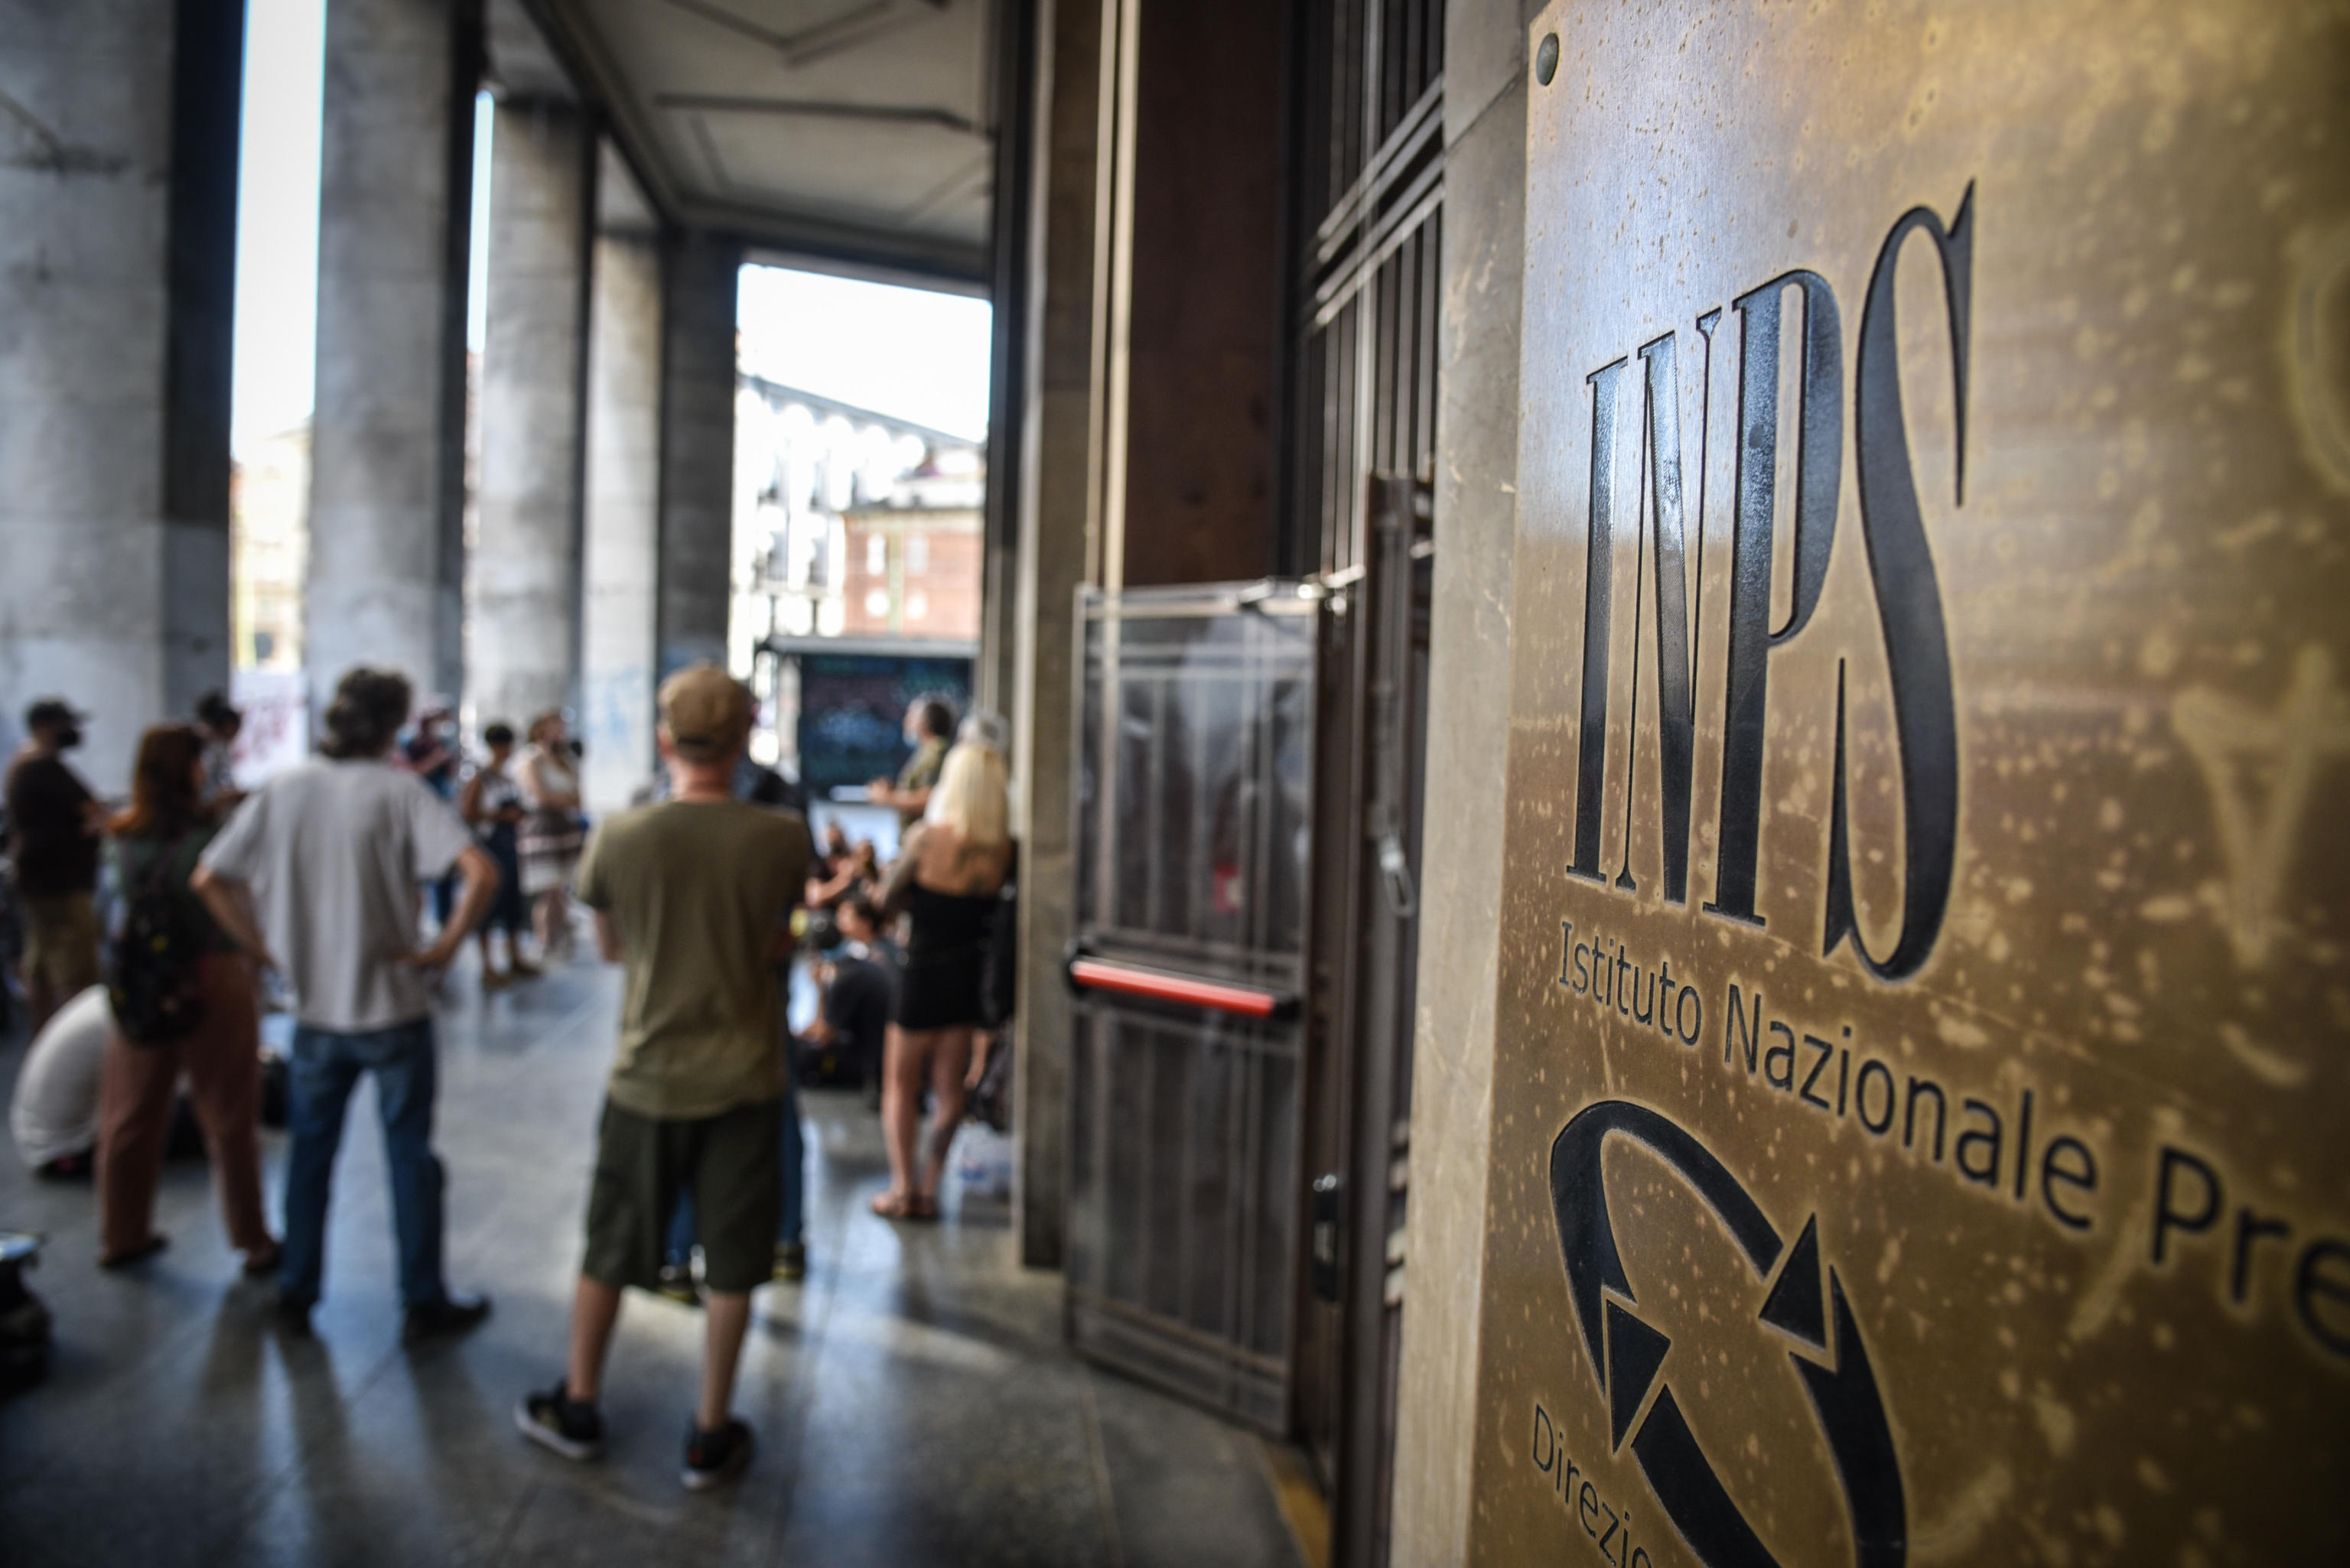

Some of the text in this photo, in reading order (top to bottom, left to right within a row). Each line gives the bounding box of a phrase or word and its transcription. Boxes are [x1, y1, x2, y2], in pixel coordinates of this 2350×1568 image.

[1566, 178, 1975, 981] INPS
[1559, 921, 1701, 1046] Istituto
[1724, 984, 2097, 1231] Nazionale
